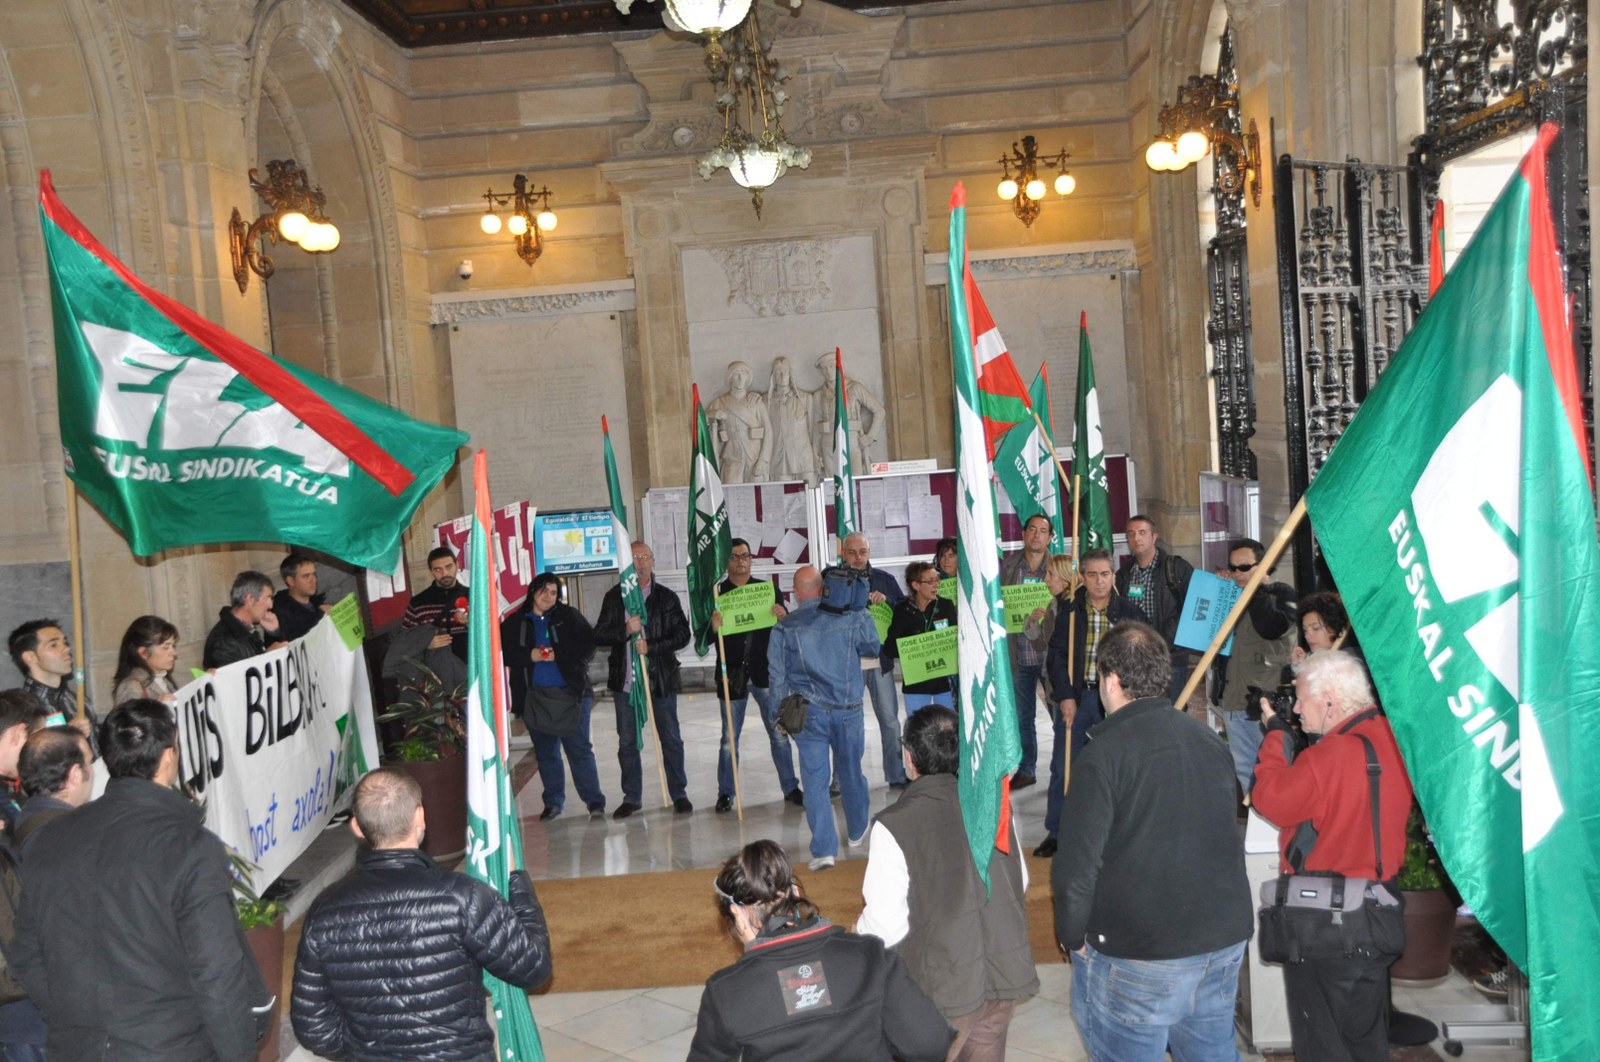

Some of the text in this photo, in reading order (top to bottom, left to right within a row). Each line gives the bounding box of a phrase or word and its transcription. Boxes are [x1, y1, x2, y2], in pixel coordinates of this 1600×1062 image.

[174, 456, 339, 505] SINDIKATUA
[1014, 455, 1035, 495] EUSKAL
[588, 513, 610, 522] tiempo
[1387, 507, 1457, 683] EUSKAL
[734, 612, 755, 624] ELA
[1195, 597, 1210, 622] ELA
[900, 638, 918, 647] JOSE
[918, 634, 935, 643] LUIS
[925, 657, 946, 671] ELA
